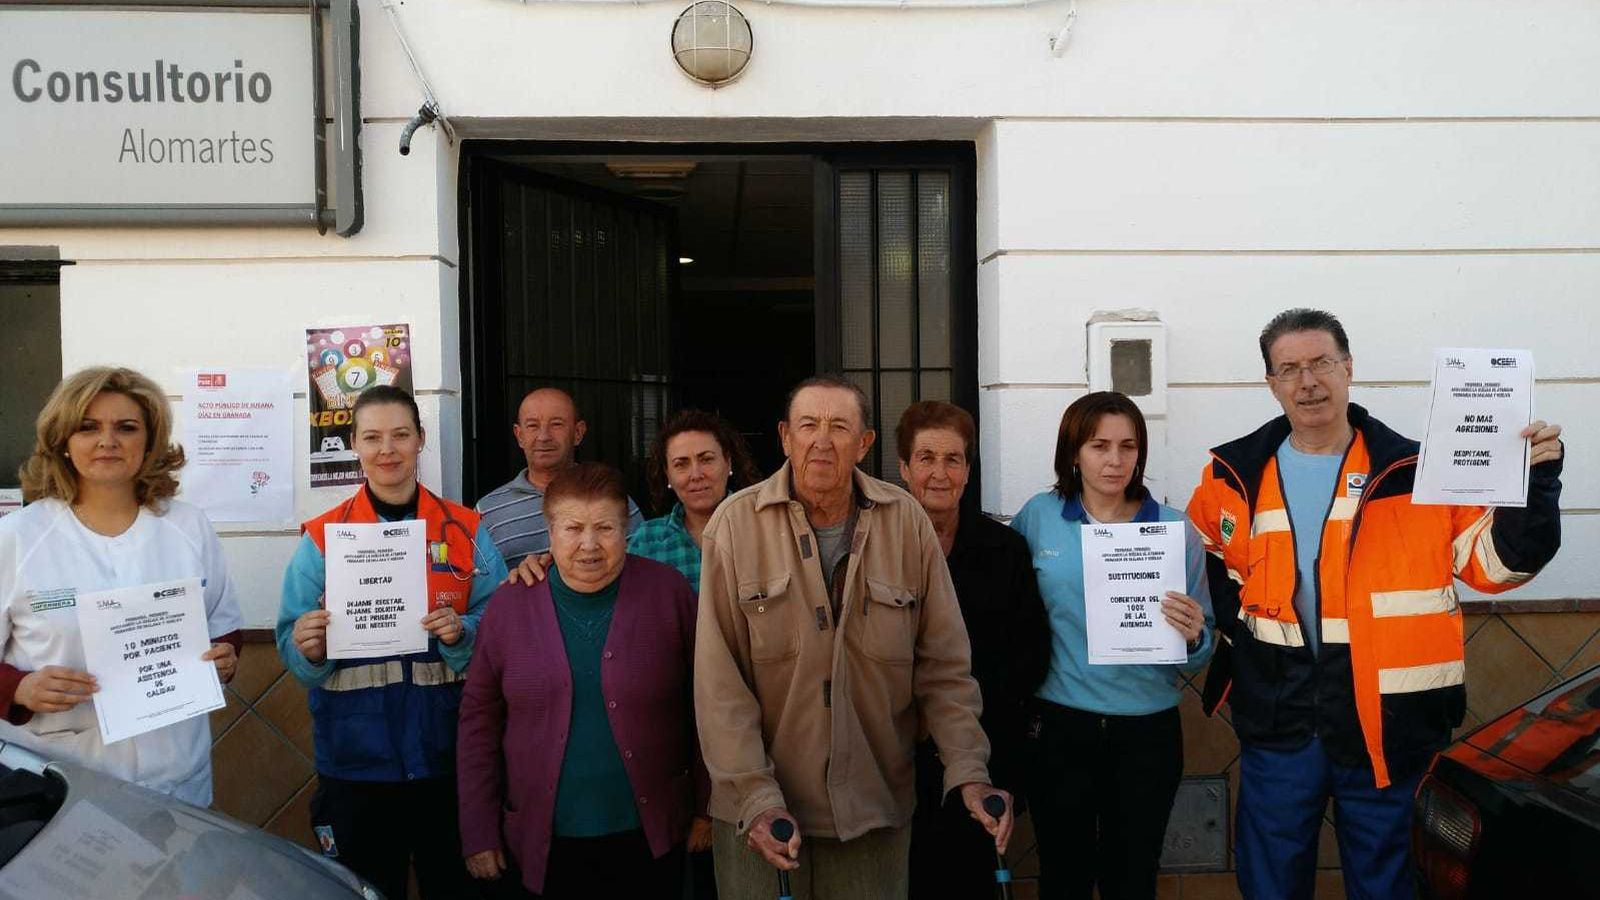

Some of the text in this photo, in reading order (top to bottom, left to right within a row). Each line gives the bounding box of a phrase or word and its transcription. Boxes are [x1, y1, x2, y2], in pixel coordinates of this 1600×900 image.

[12, 58, 272, 103] Consultorio
[118, 128, 274, 163] Alomartes
[386, 337, 400, 348] 10
[351, 372, 361, 386] 7
[1464, 414, 1493, 423] NO MAS
[1455, 425, 1499, 433] AGRESIONES
[359, 576, 392, 585] LIBERTAD
[1108, 572, 1160, 581] SUSTITUCIONES
[1149, 595, 1160, 603] DEL
[370, 613, 397, 621] PRUEBAS
[370, 621, 396, 629] NECESITE
[124, 633, 179, 651] 10 MINUTOS
[123, 641, 182, 661] POR PACIENTE
[138, 660, 172, 674] POR UNA
[137, 668, 178, 683] ASISTENCIA
[154, 679, 164, 688] DE
[146, 685, 176, 698] CALIDAD
